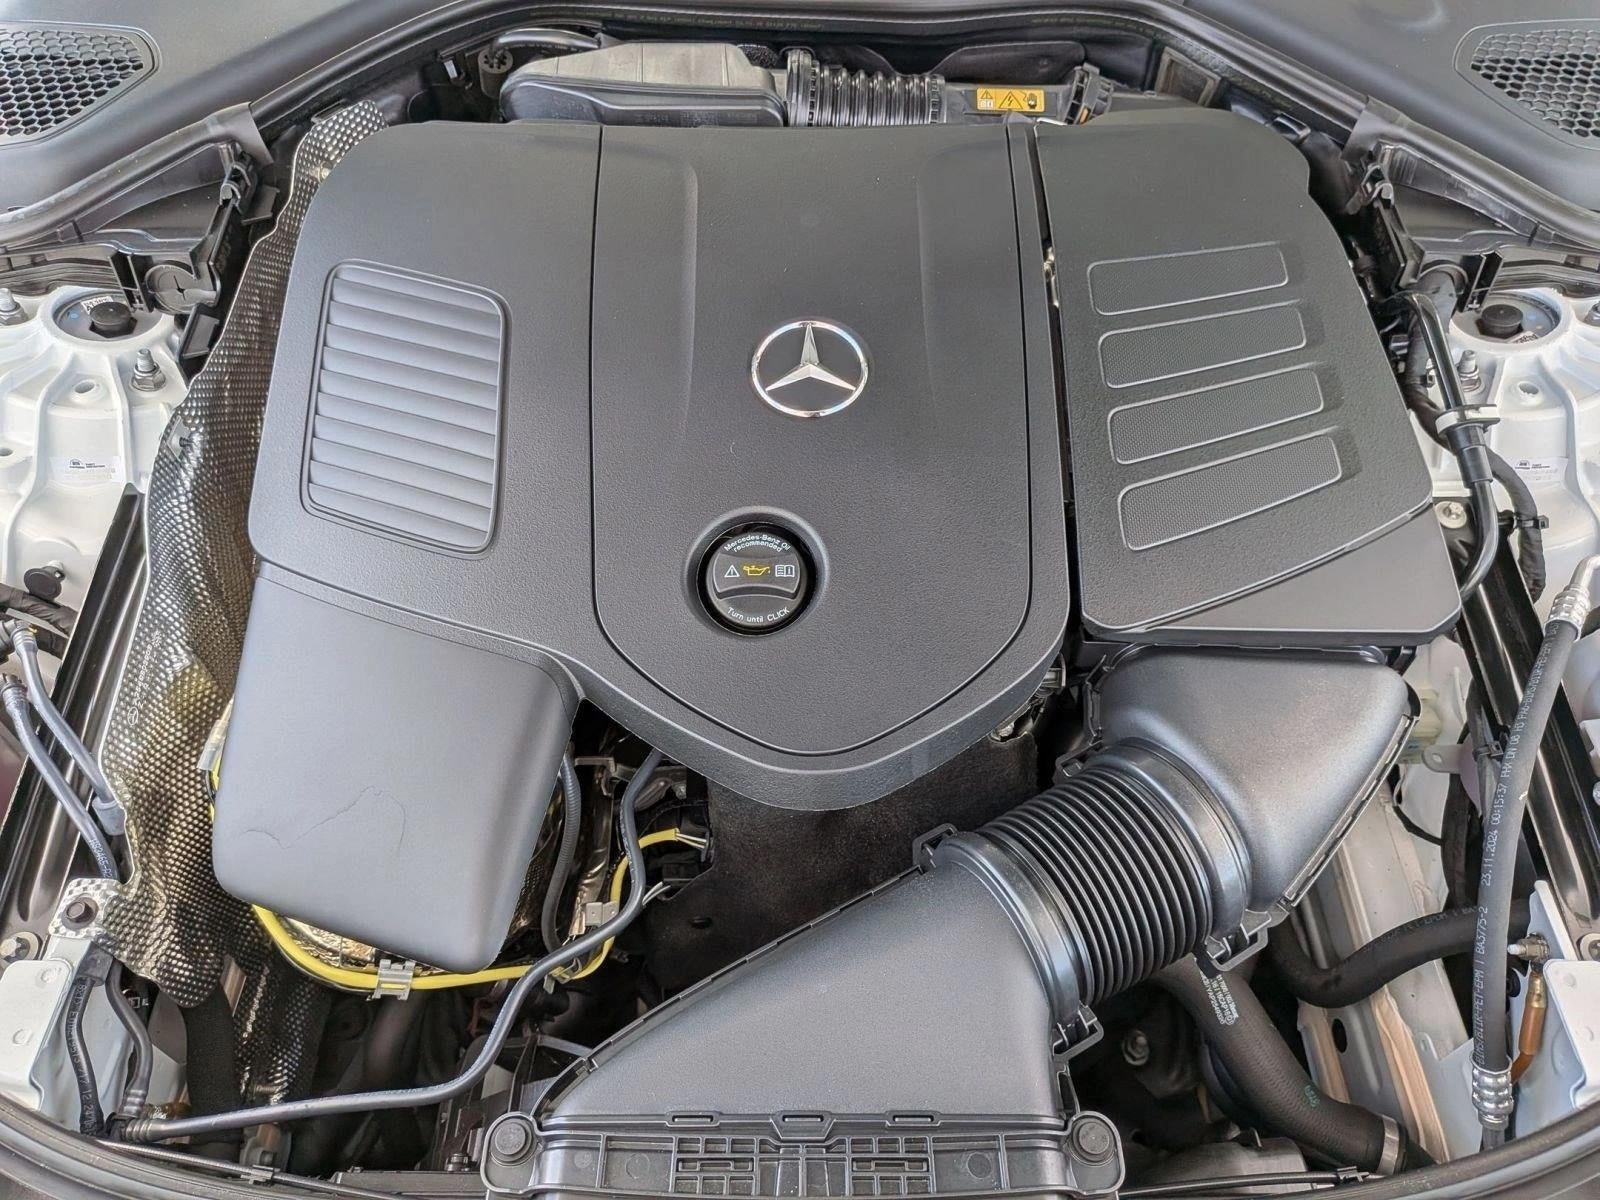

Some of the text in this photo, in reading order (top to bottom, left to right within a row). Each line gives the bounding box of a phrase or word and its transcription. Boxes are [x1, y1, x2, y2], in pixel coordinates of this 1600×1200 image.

[724, 534, 791, 552] Mercedes-Benz Oil
[733, 540, 782, 553] recommended
[727, 606, 791, 623] Turn until CLICK
[1481, 829, 1499, 887] 23.11.2024
[1490, 783, 1508, 825] 00:15:37
